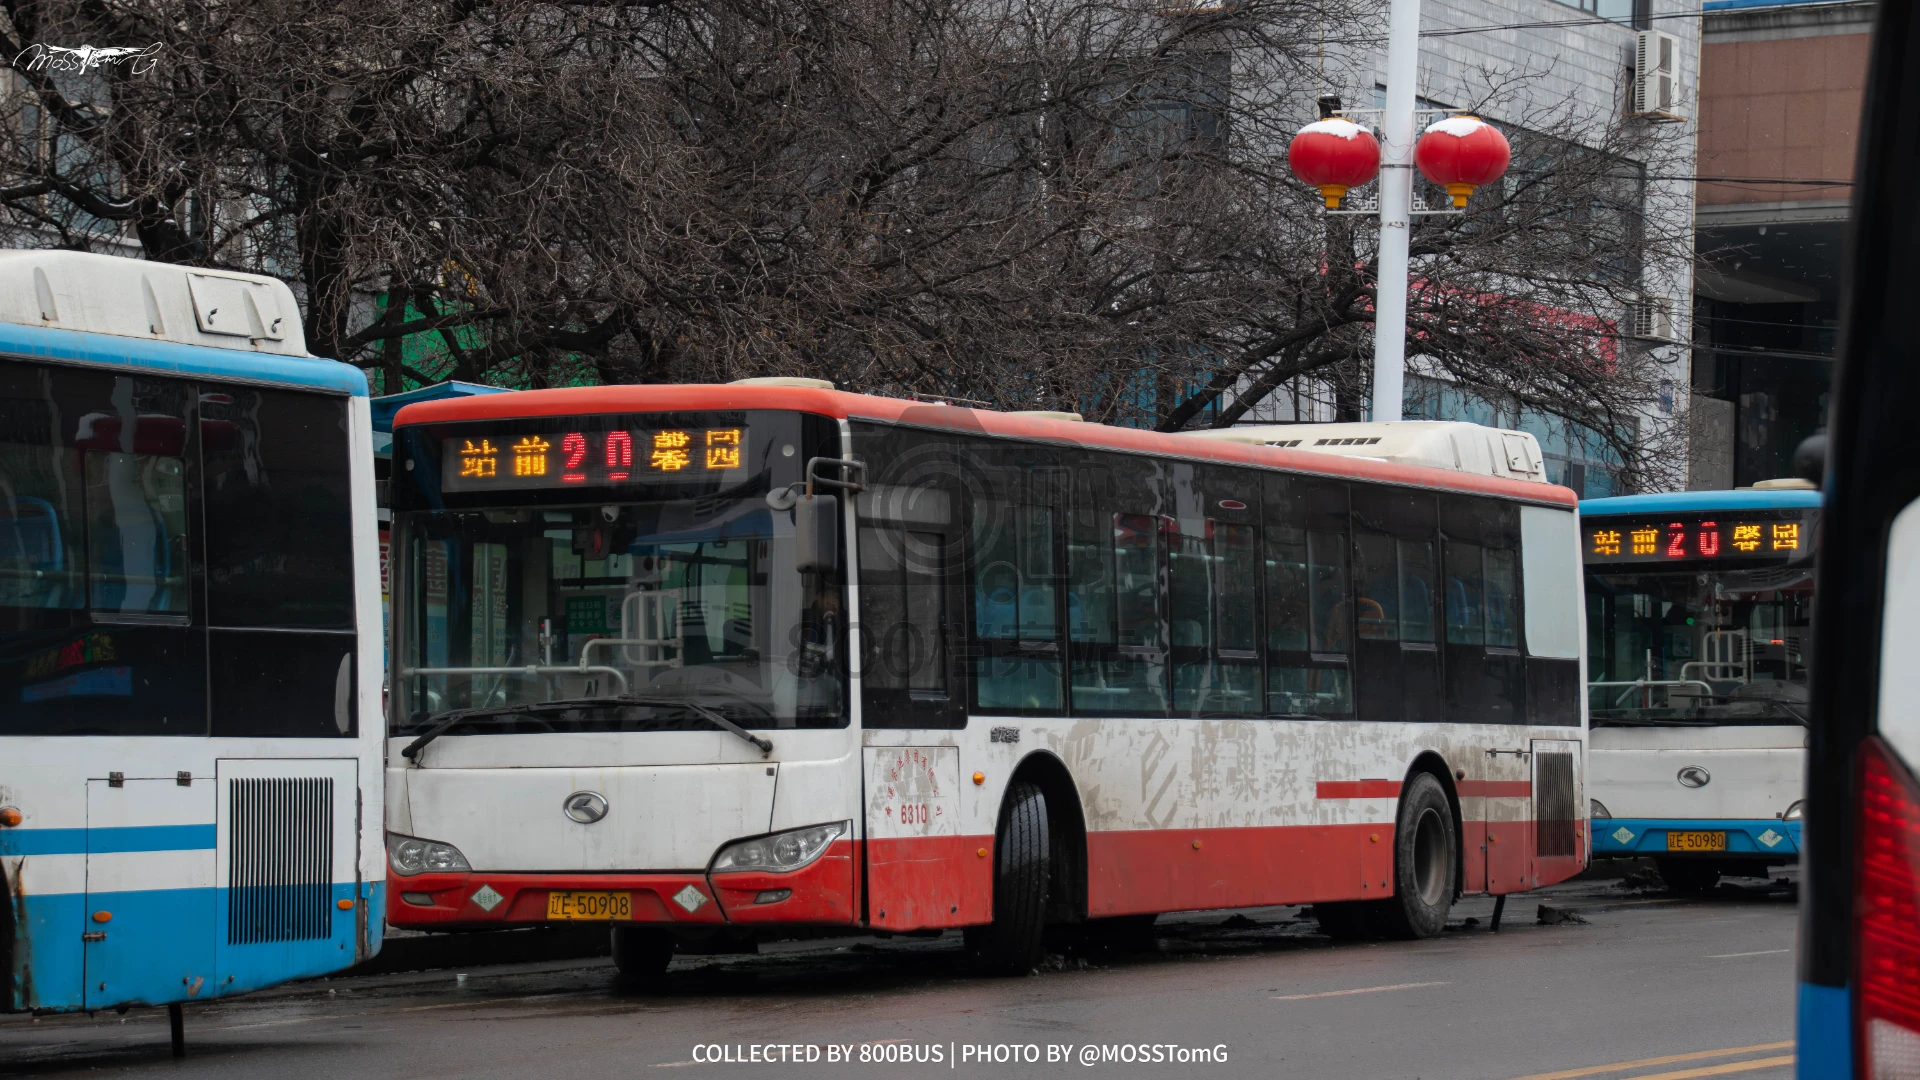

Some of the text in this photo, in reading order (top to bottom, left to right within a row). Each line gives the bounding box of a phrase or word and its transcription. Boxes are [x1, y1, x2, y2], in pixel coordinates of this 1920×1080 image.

[460, 429, 740, 481] 站前 20 馨园
[1593, 524, 1659, 555] 站前
[1668, 521, 1719, 556] 20
[901, 804, 927, 824] 6310
